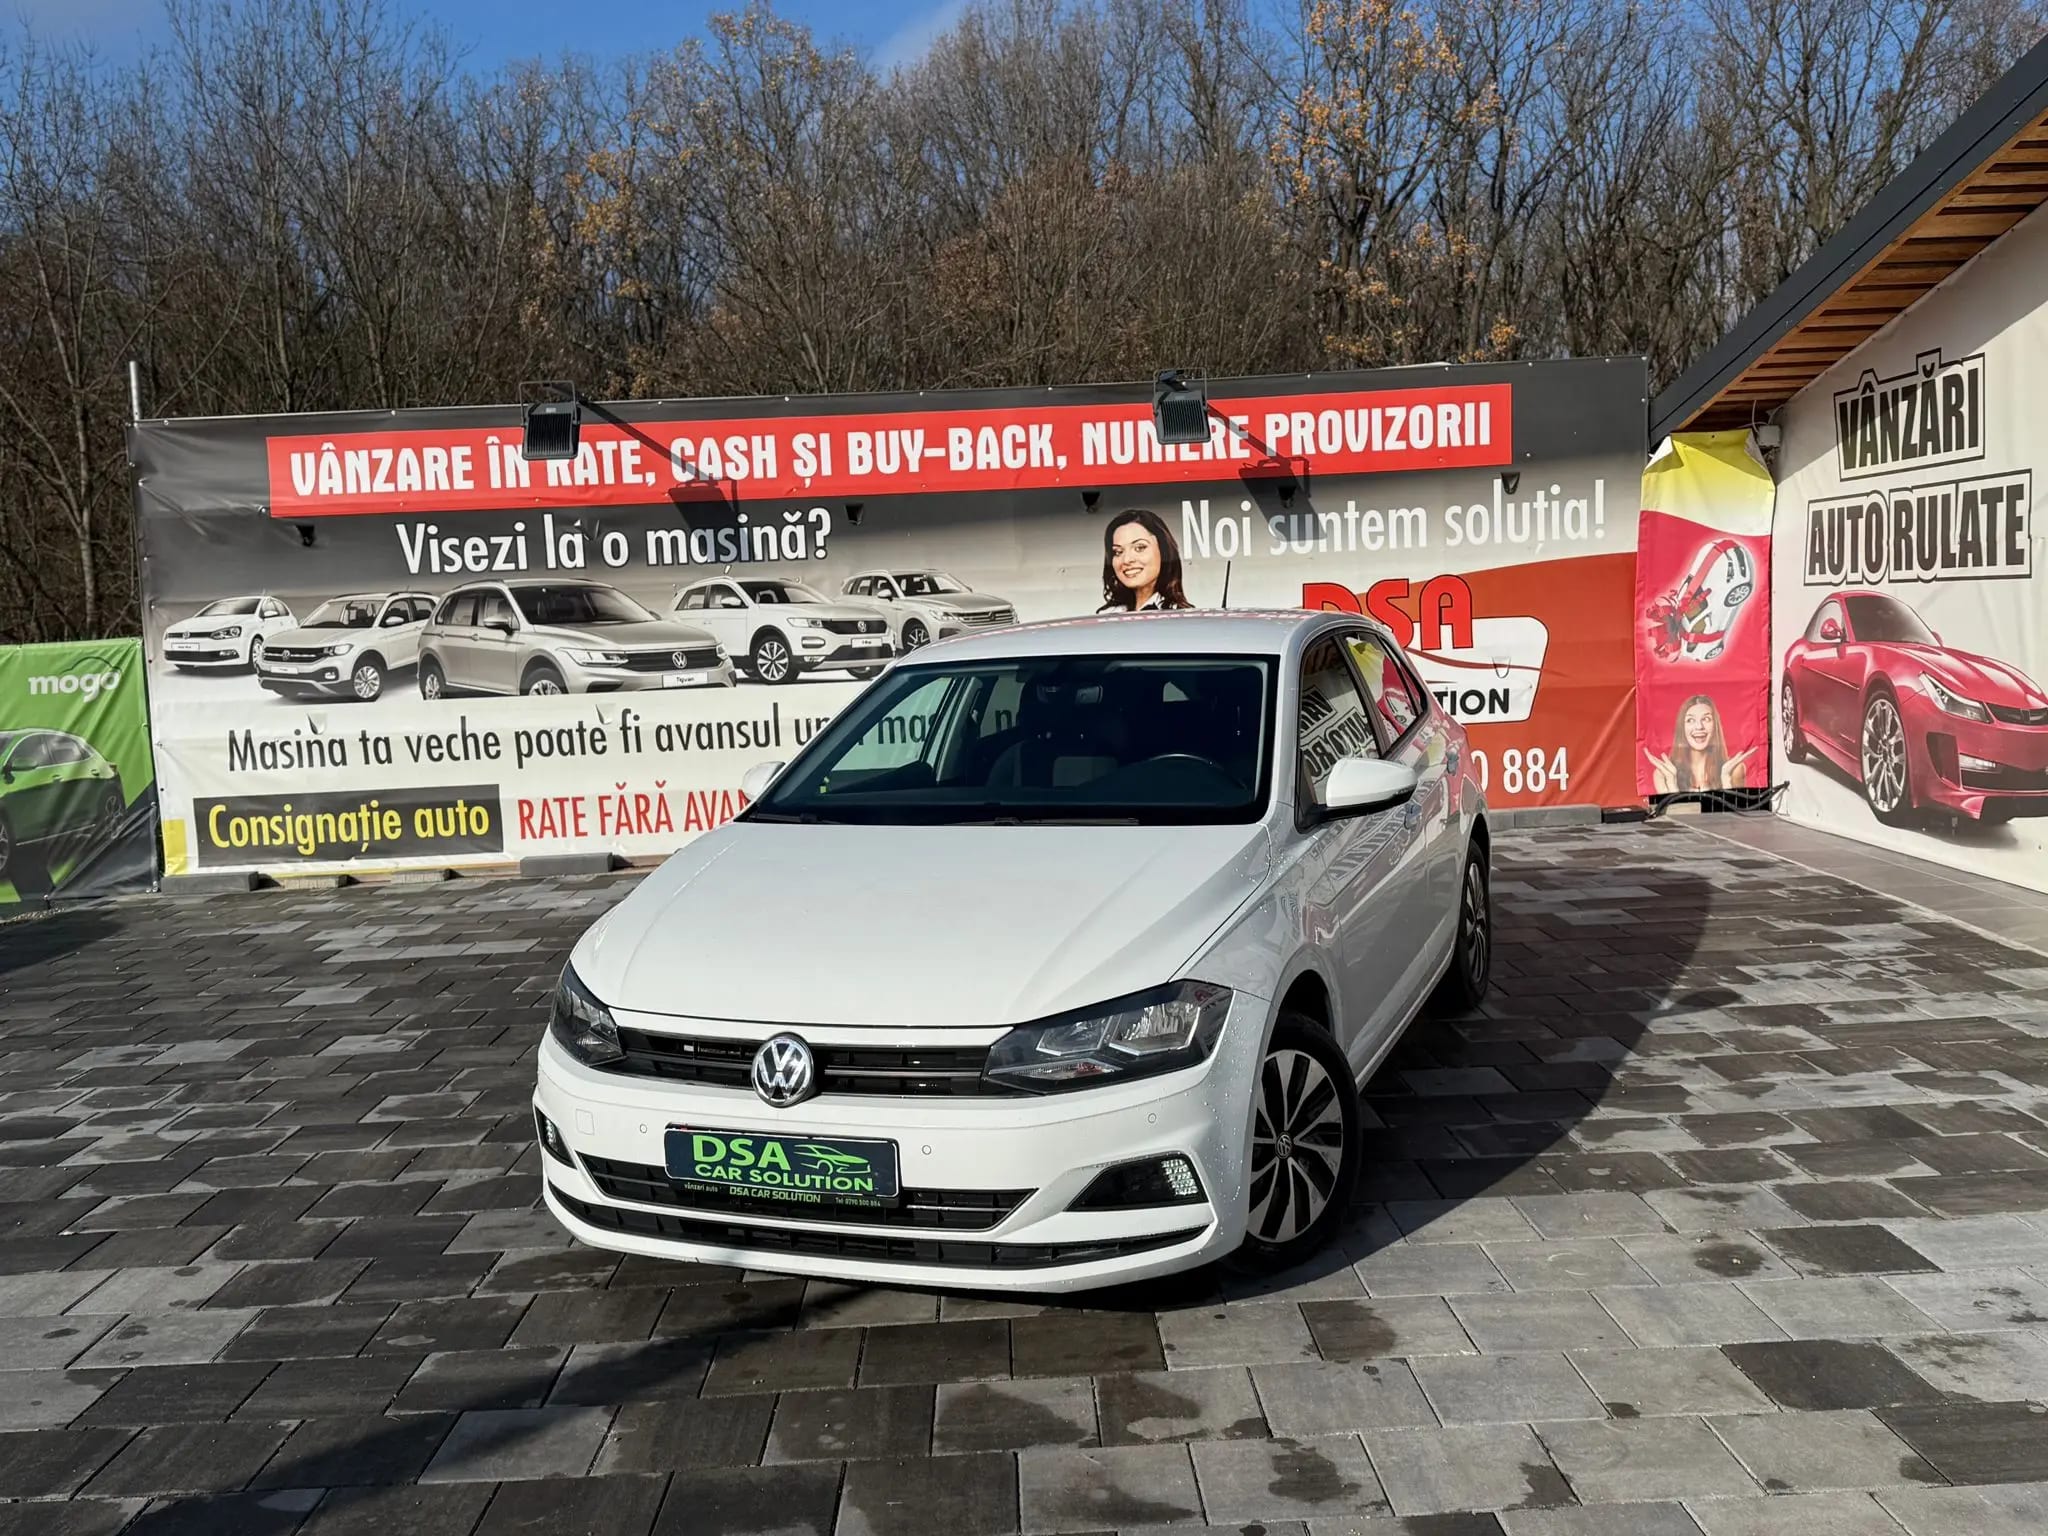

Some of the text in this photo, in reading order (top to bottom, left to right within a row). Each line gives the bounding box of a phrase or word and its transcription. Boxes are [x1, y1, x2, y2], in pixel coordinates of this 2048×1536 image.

[1838, 362, 1980, 470] VÂNZĂRI
[290, 442, 475, 497] VÂNZARE
[486, 435, 532, 489] ÎN
[546, 439, 656, 487] RATE,
[670, 434, 778, 480] CASH
[792, 431, 833, 488] ȘI
[847, 423, 1067, 475] BUY-BACK,
[1264, 400, 1492, 458] PROVIZORII
[395, 520, 529, 575] Visezi
[543, 513, 587, 570] la
[601, 530, 630, 568] o
[1181, 478, 1606, 561] Noi suntem soluția!
[1808, 482, 2027, 578] AUTO RULATE
[28, 670, 121, 702] mogo
[359, 730, 393, 766] ta
[407, 715, 501, 764] veche
[514, 719, 608, 769] poate
[619, 708, 642, 754] fi
[655, 702, 781, 752] avansul
[1502, 746, 1570, 794] 884
[208, 802, 490, 855] Consignație auto
[518, 796, 588, 840] RATE
[598, 780, 675, 837] FĂRĂ
[692, 1134, 791, 1171] DSA
[694, 1164, 874, 1192] CAR SOLUTION
[729, 1186, 821, 1203] DSA CAR SOLUTION
